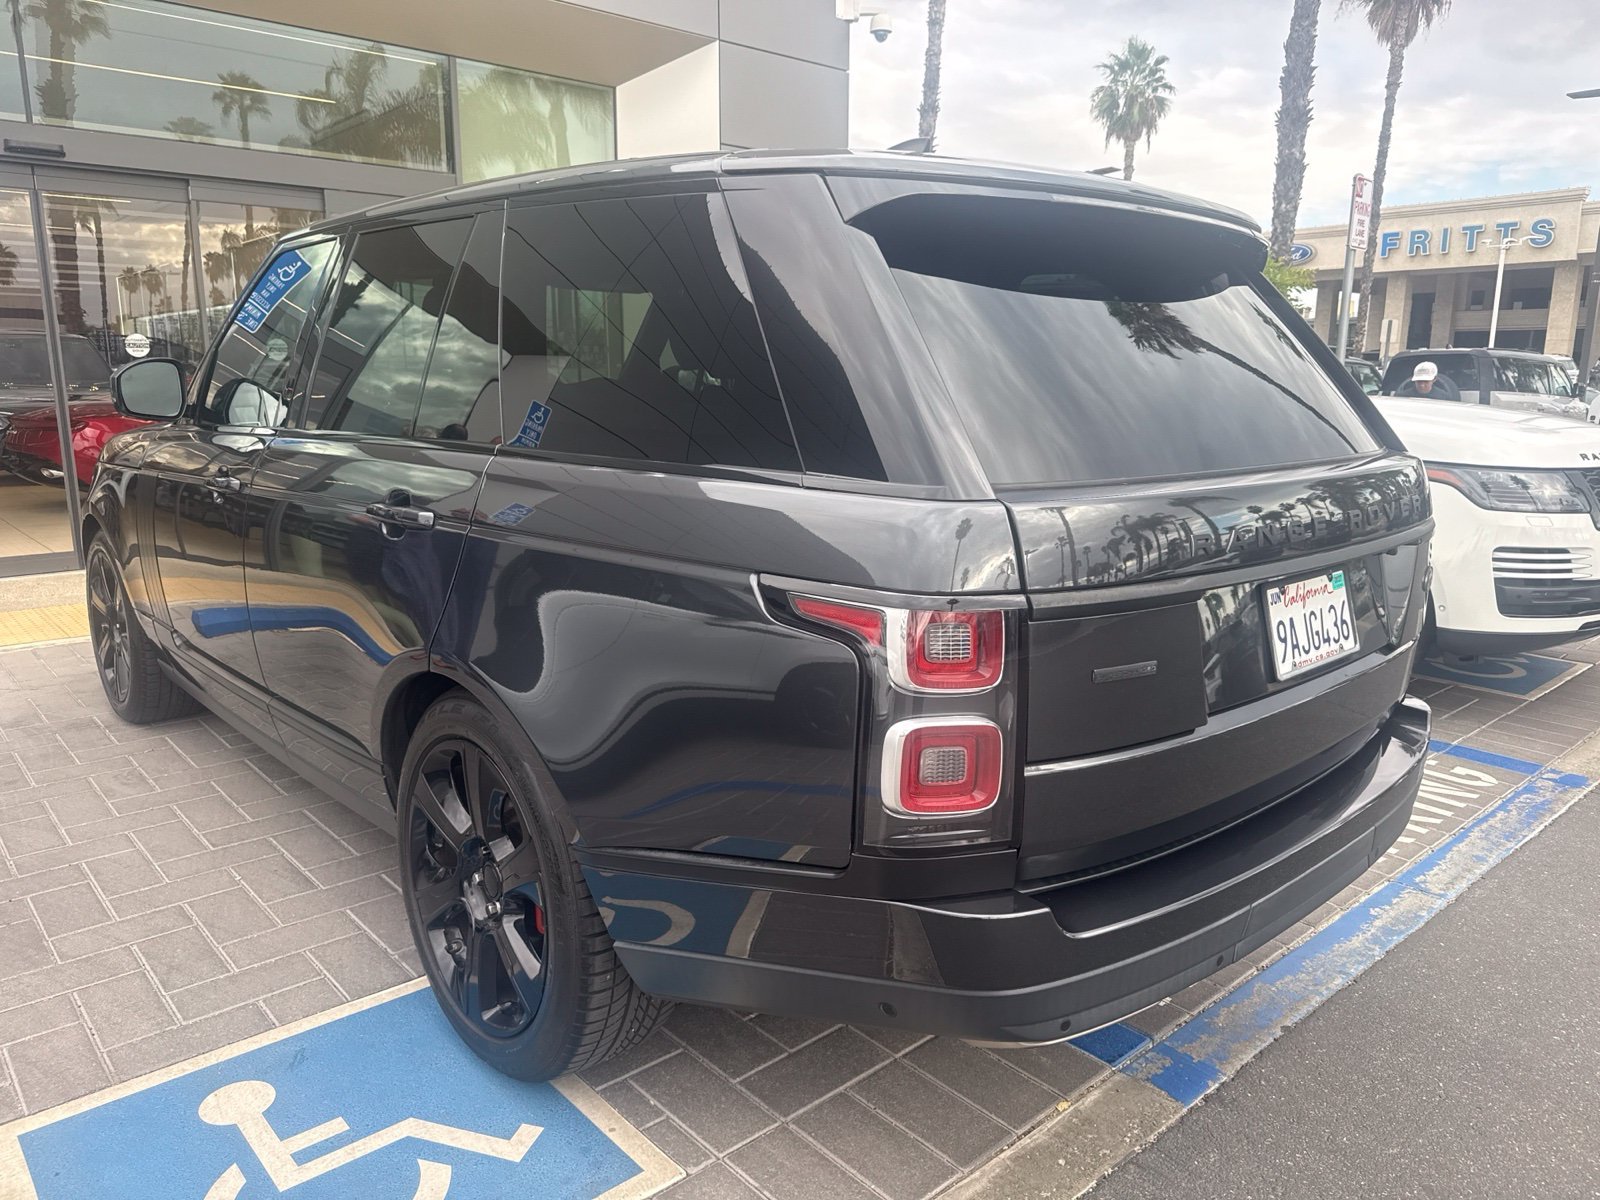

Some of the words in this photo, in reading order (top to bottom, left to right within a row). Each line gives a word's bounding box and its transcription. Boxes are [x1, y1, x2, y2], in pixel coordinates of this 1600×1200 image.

[1380, 218, 1555, 258] FRITTS
[1579, 453, 1600, 461] RA
[1190, 516, 1328, 558] RANGE
[1350, 494, 1421, 531] ROVER
[1269, 591, 1282, 607] JUN
[1283, 581, 1334, 609] California
[1276, 599, 1350, 664] 9AJG436
[1297, 649, 1339, 668] dmv.ca.gov
